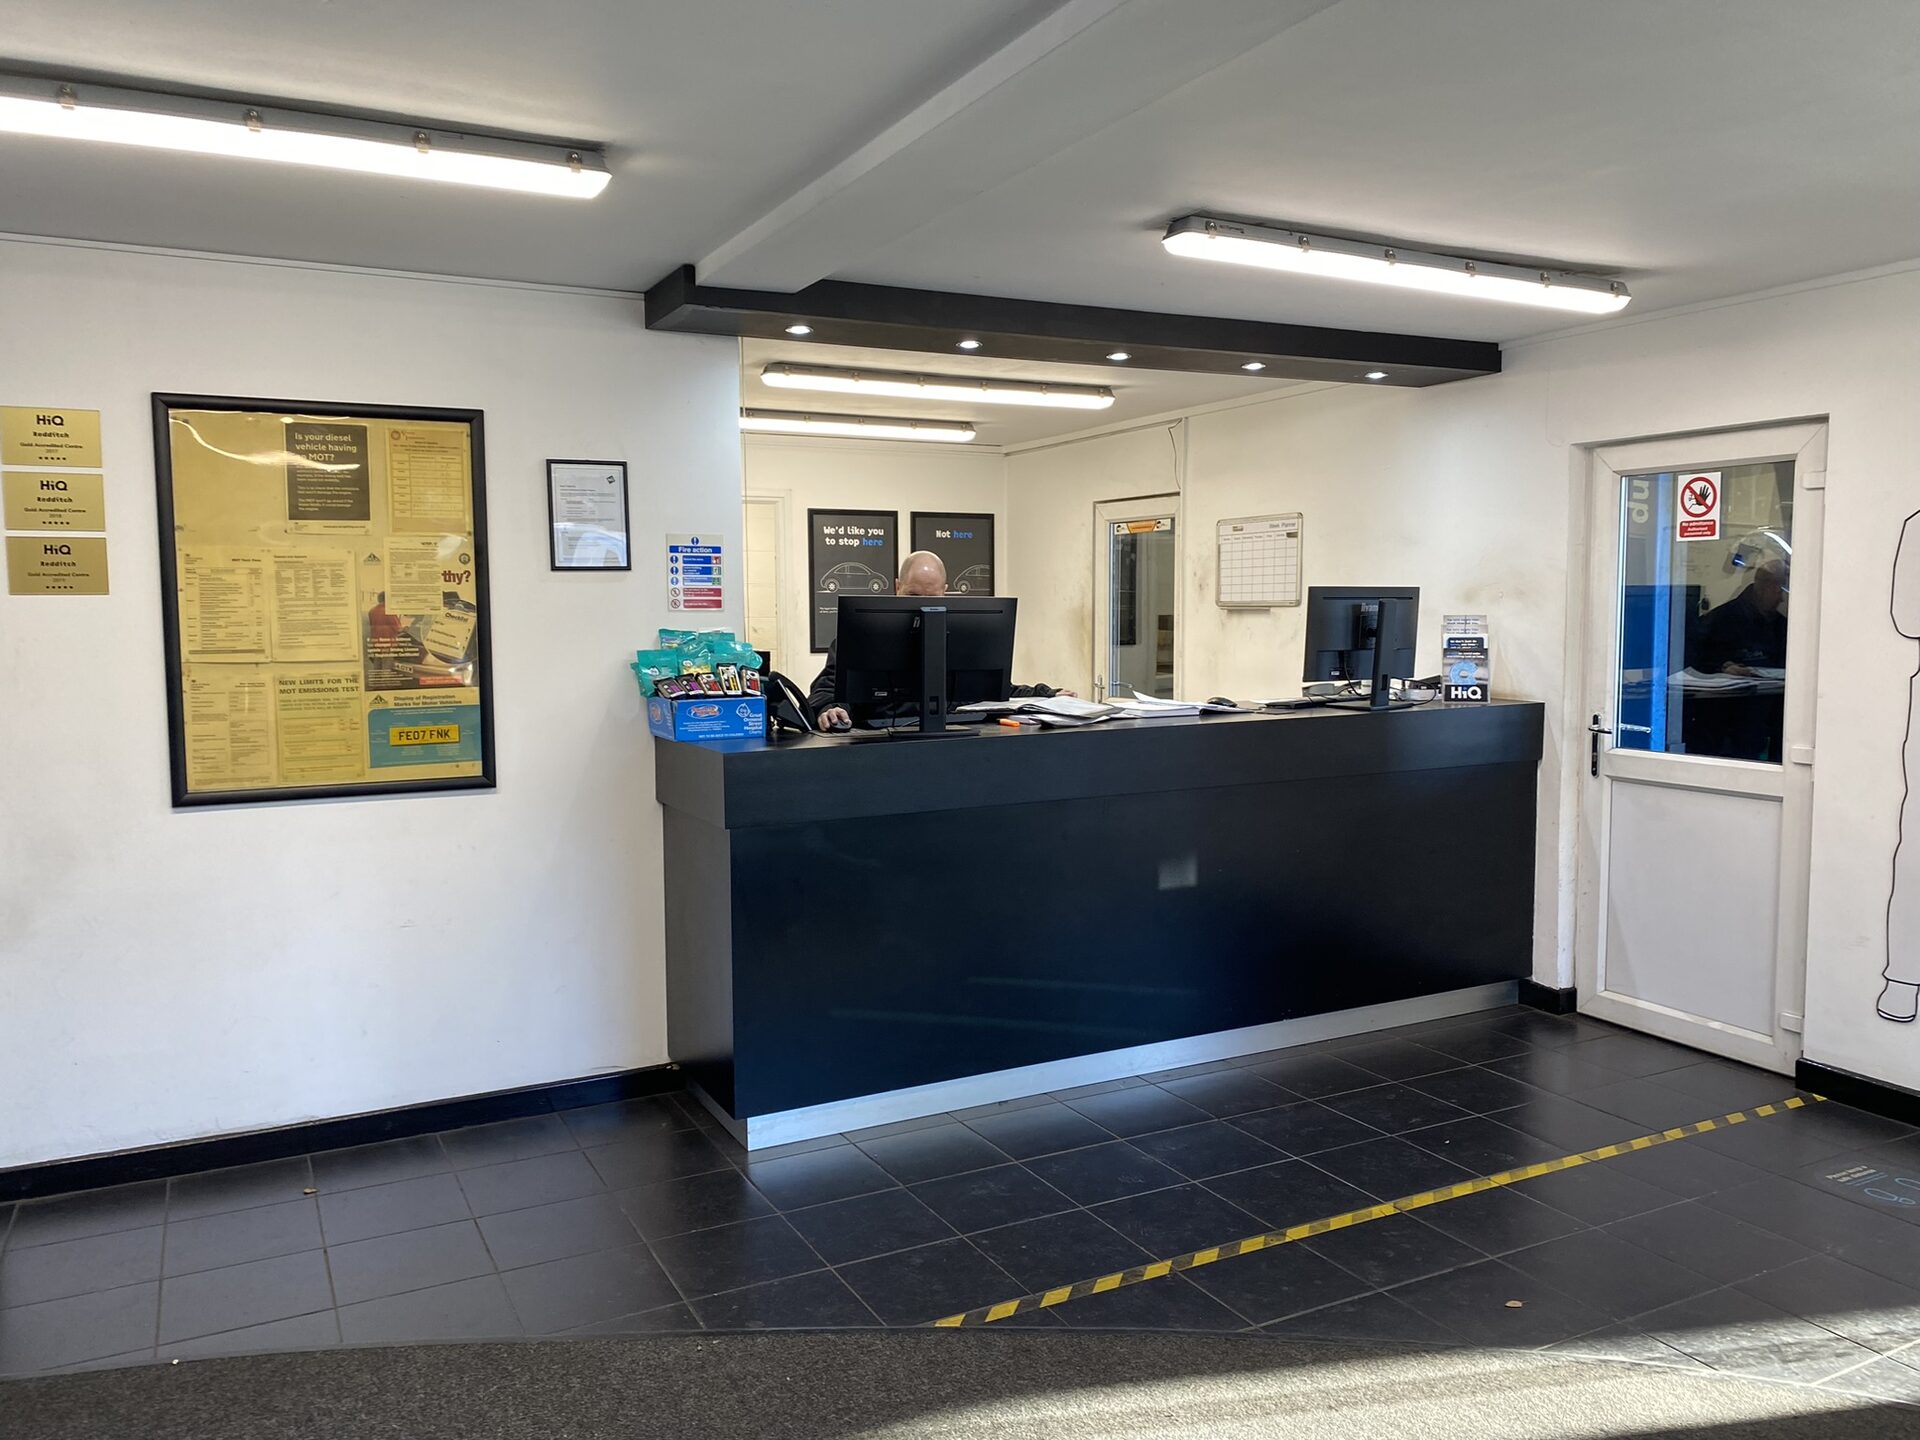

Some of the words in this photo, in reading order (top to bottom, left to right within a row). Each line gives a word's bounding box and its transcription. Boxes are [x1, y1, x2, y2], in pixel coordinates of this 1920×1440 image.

[36, 414, 65, 426] HiQ
[295, 432, 303, 440] Is
[304, 434, 324, 442] your
[325, 433, 352, 442] diesel
[295, 442, 328, 451] vehicle
[328, 443, 357, 454] having
[308, 453, 336, 462] MOT?
[40, 480, 68, 491] HiQ
[824, 526, 845, 536] We'd
[847, 526, 865, 536] like
[867, 528, 884, 538] you
[936, 530, 952, 539] Not
[953, 530, 974, 540] here
[825, 536, 836, 546] to
[838, 536, 860, 548] stop
[862, 538, 884, 546] here
[43, 544, 72, 556] HiQ
[1450, 686, 1482, 700] HiQ
[398, 730, 427, 742] FE07
[429, 728, 450, 740] FNK
